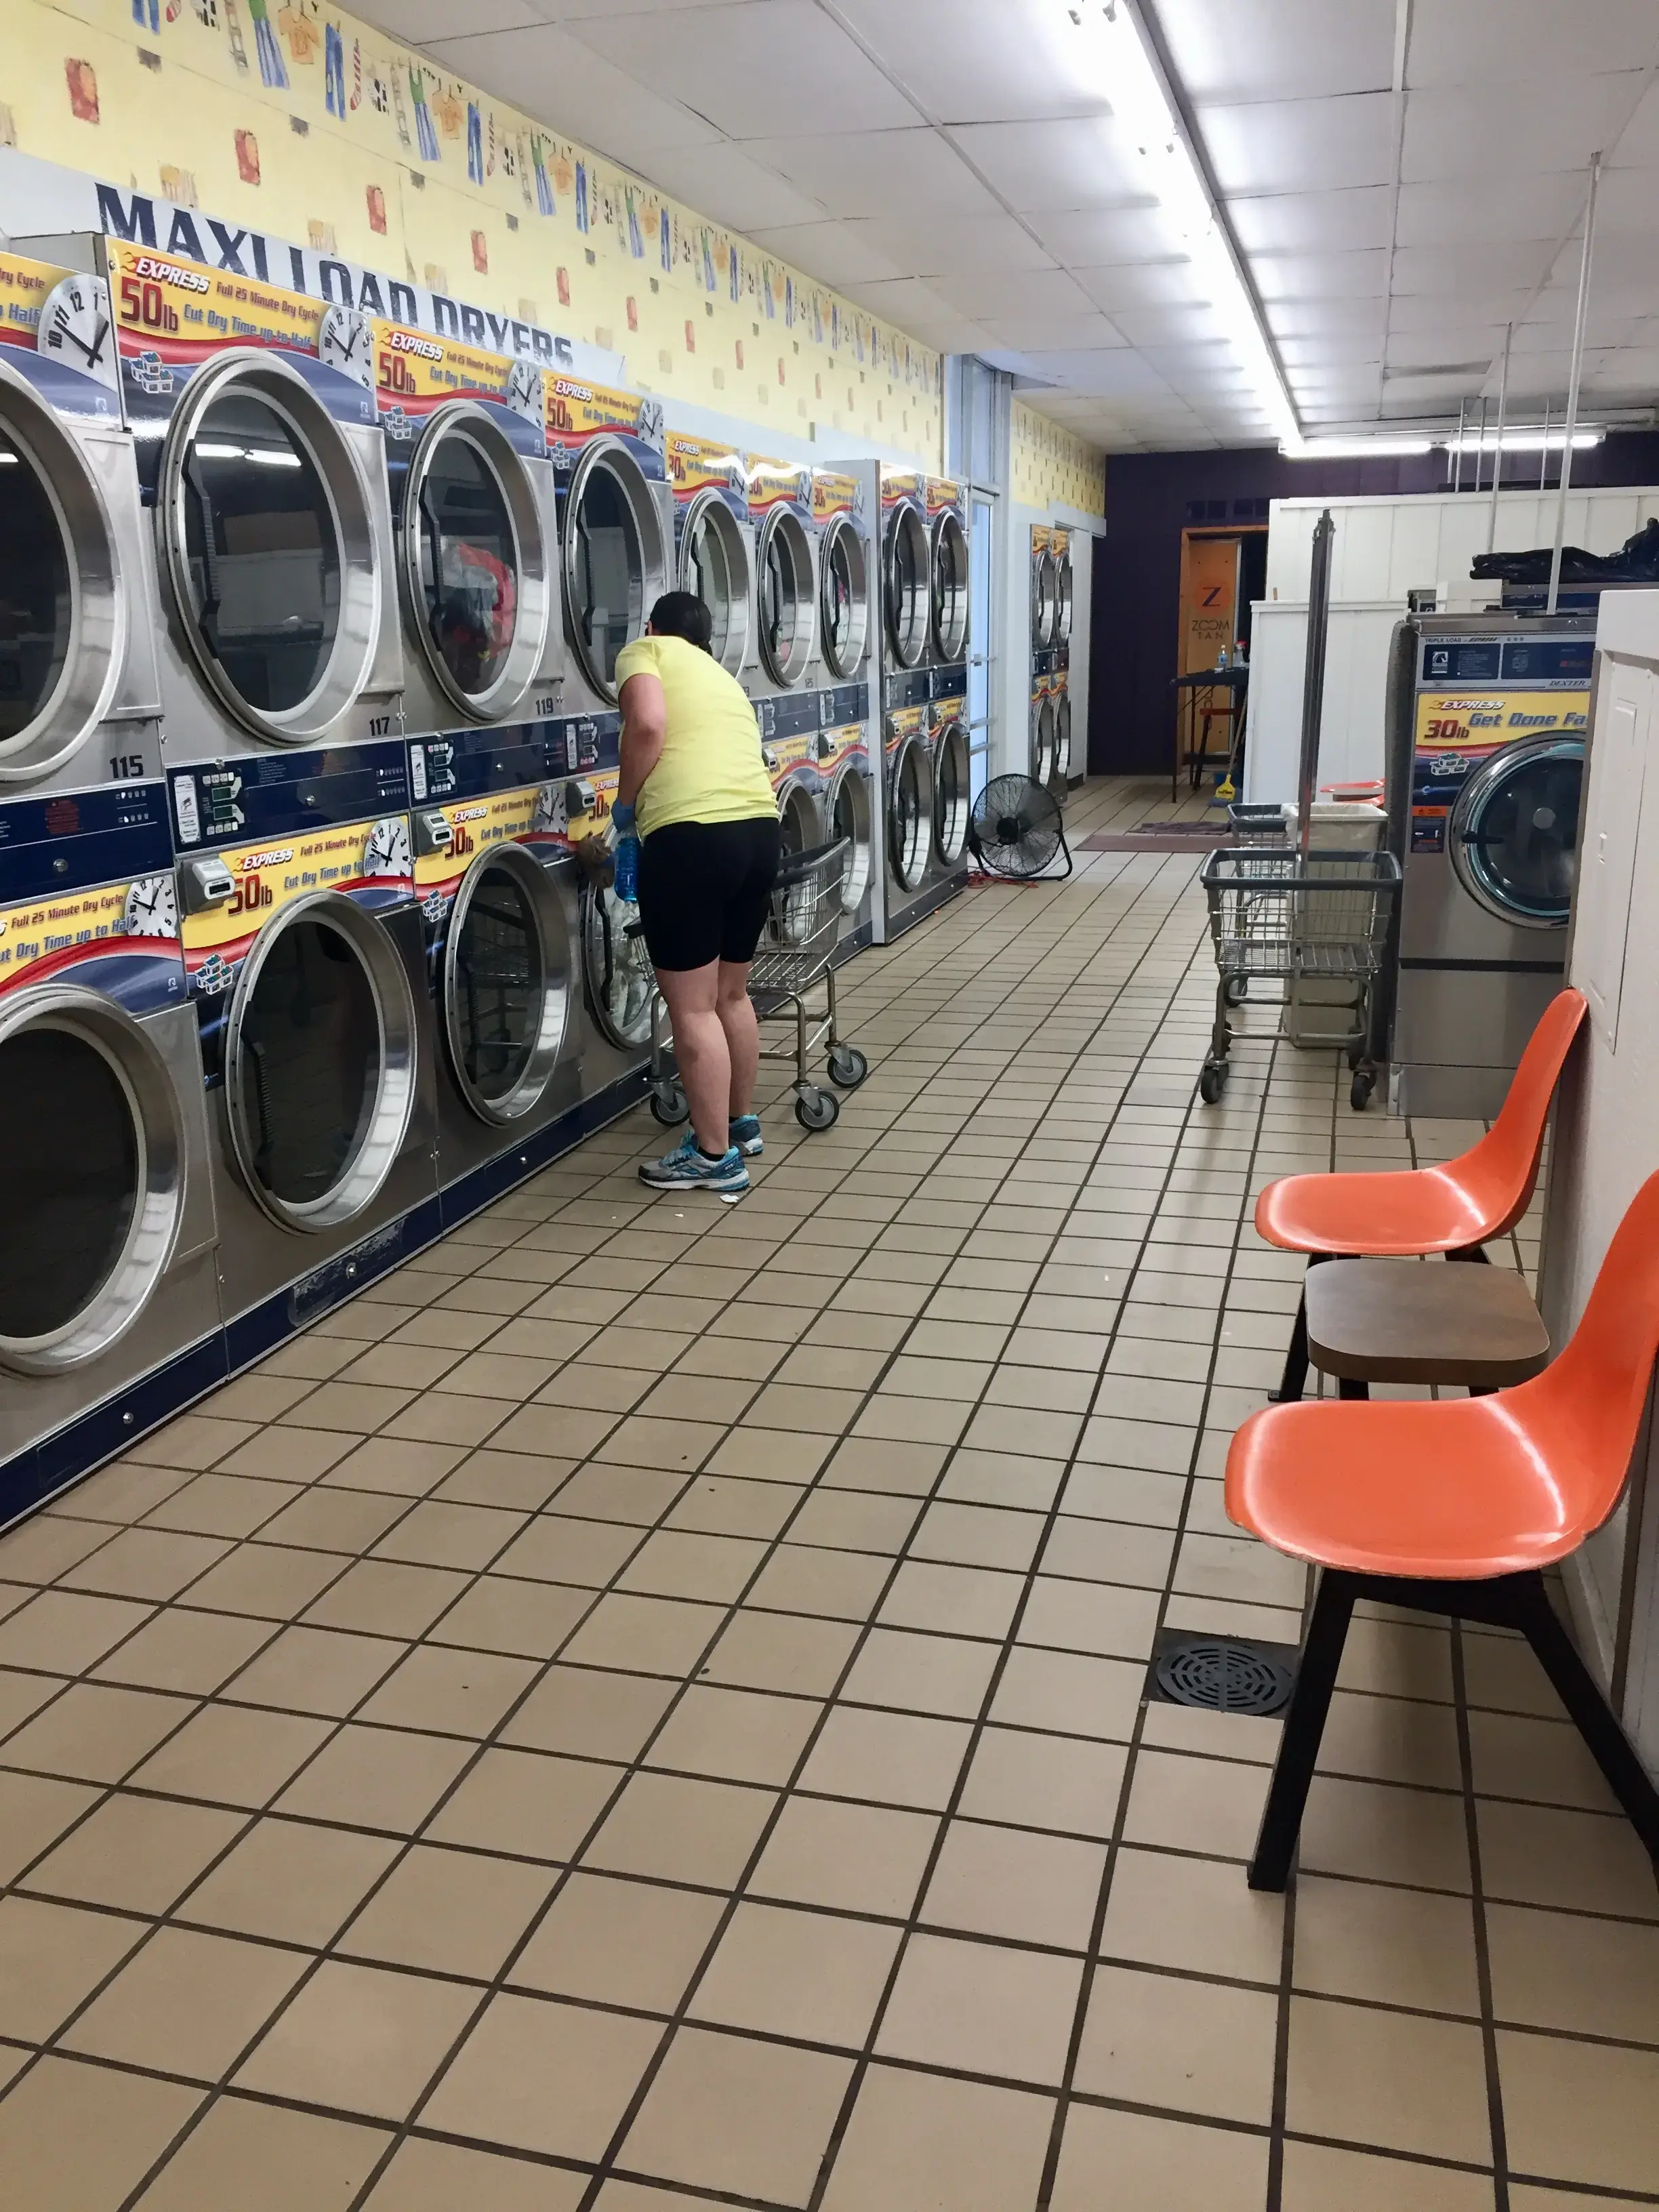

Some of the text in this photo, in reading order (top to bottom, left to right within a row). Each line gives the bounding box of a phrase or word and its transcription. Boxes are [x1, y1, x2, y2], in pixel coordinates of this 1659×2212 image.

[0, 268, 45, 289] ry Cycle
[94, 182, 270, 283] MAXI
[432, 294, 573, 367] DRYERS
[136, 257, 210, 295] EXPRESS
[70, 291, 84, 312] 12
[94, 292, 98, 311] 1
[121, 276, 178, 332] 50lb
[216, 282, 319, 321] Full 25 Minute Dry Cycle
[9, 302, 42, 326] Half
[55, 304, 70, 326] 11
[184, 304, 203, 322] Cut
[207, 310, 227, 331] Dry
[231, 316, 257, 335] Time
[290, 332, 312, 350] Half
[47, 329, 62, 349] 10
[390, 332, 445, 362] EXPRESS
[379, 351, 416, 394] 50lb
[556, 380, 593, 403] EXPRESS
[547, 397, 573, 430] 50lb
[1202, 587, 1222, 607] Z
[1192, 619, 1230, 631] ZOOM
[1198, 631, 1223, 640] TAN
[536, 697, 554, 715] 119
[1440, 700, 1506, 710] EXPRESS
[369, 716, 390, 737] 117
[1424, 719, 1470, 739] 30lb
[1468, 712, 1503, 727] Get
[1508, 712, 1558, 727] Done
[110, 754, 144, 779] 115
[454, 806, 489, 824] EXPRESS
[243, 849, 295, 872] EXPRESS
[283, 876, 299, 890] Cut
[302, 872, 317, 886] Dry
[319, 867, 339, 880] Time
[11, 915, 28, 928] Full
[31, 910, 44, 924] 25
[48, 903, 80, 920] Minute
[83, 901, 98, 916] Dry
[101, 894, 123, 910] Cycle
[0, 915, 135, 963] ut Dry Time up to Half
